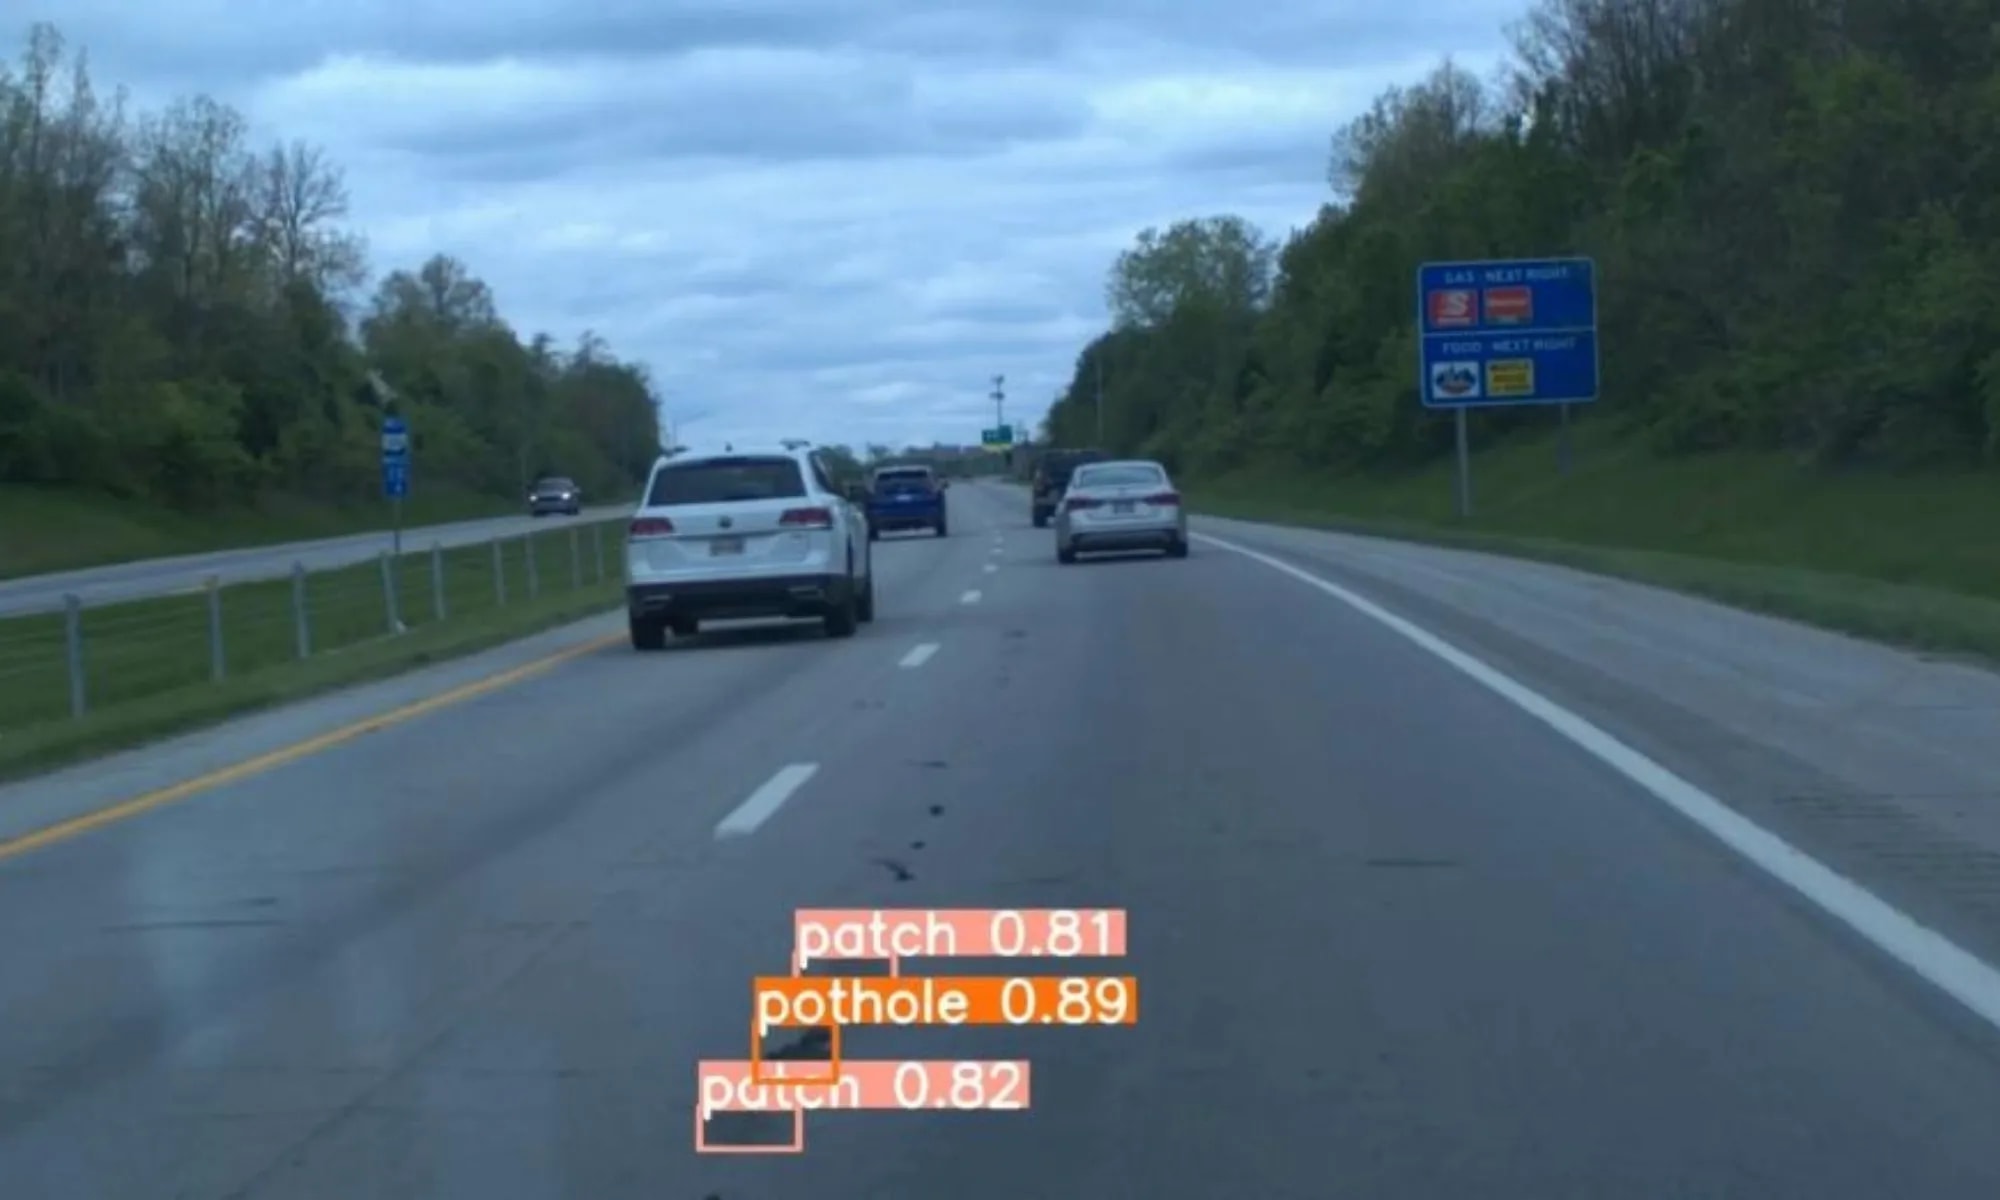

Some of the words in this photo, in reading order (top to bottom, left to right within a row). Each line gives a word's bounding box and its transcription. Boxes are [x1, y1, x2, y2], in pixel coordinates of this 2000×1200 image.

[1445, 270, 1475, 284] GAS
[1485, 268, 1523, 283] NEXT
[1442, 341, 1482, 355] FOOD
[1492, 339, 1530, 353] NEXT
